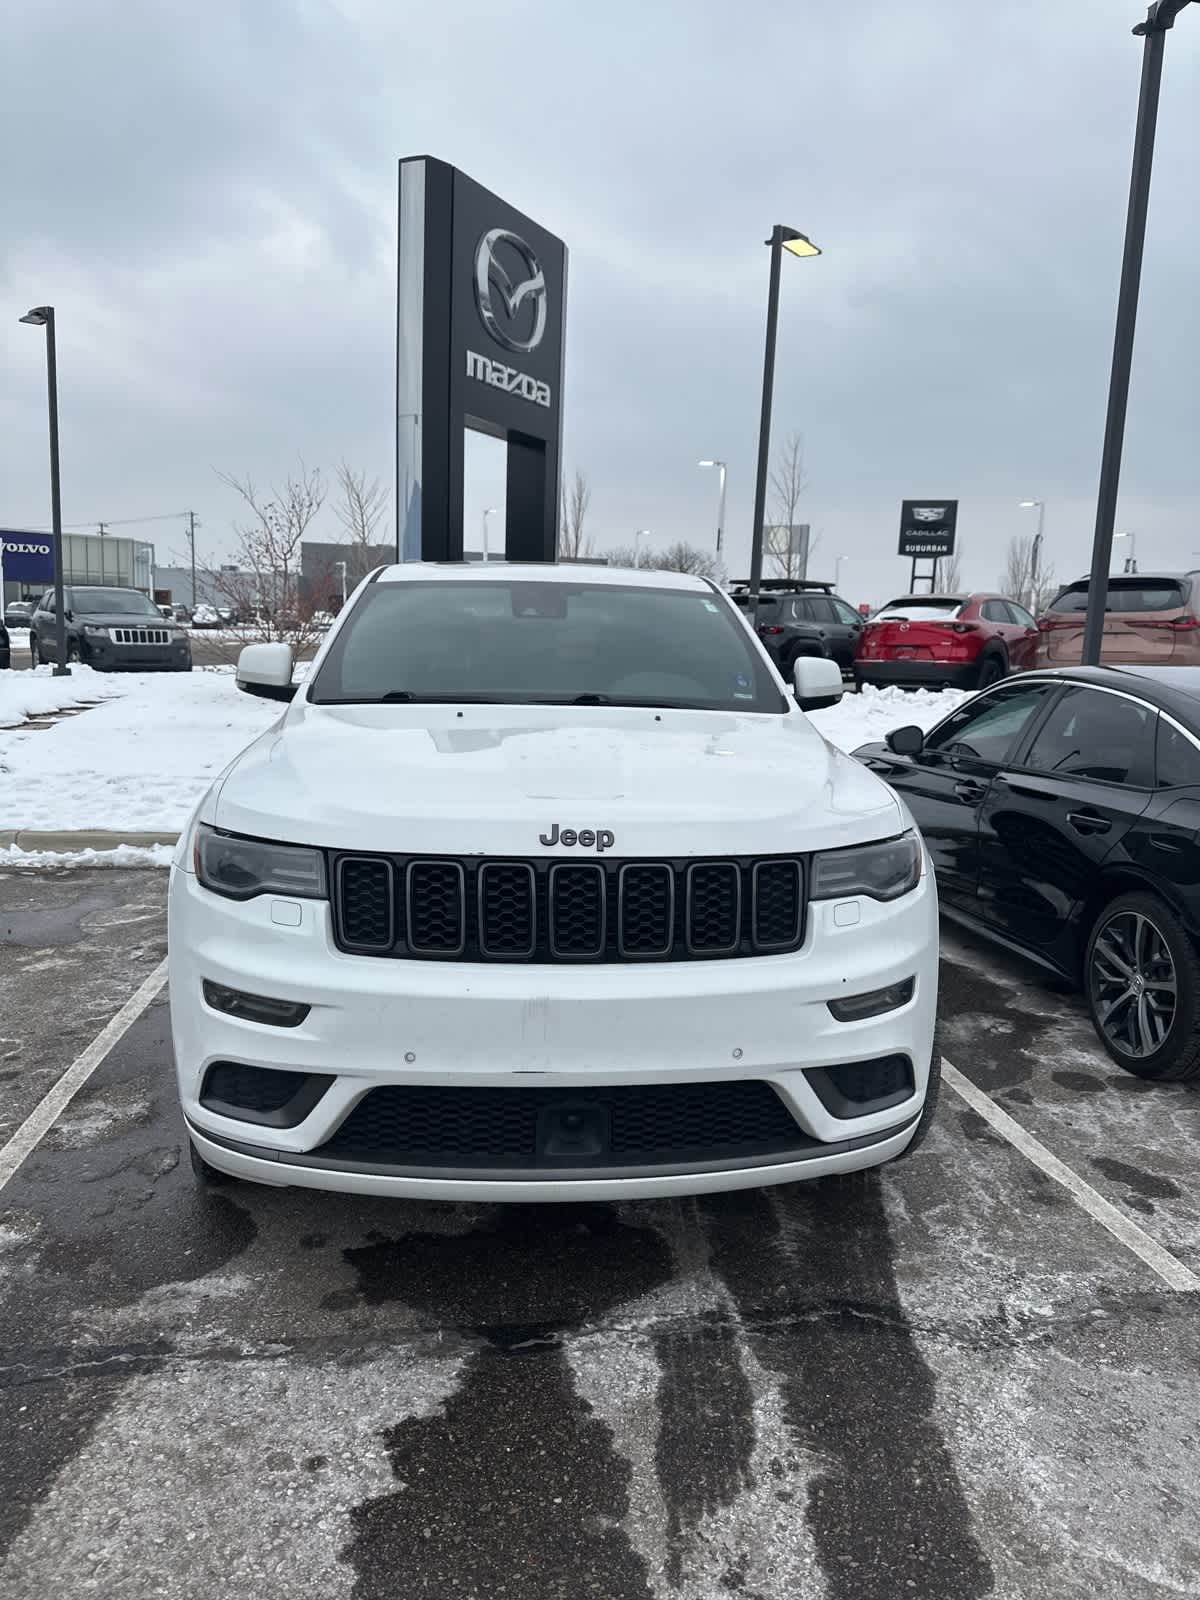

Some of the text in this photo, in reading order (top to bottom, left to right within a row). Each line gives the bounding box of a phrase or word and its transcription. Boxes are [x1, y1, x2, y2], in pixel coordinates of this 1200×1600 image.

[466, 349, 551, 408] mazda
[905, 544, 948, 552] SUBURBAN
[539, 823, 615, 852] Jeep
